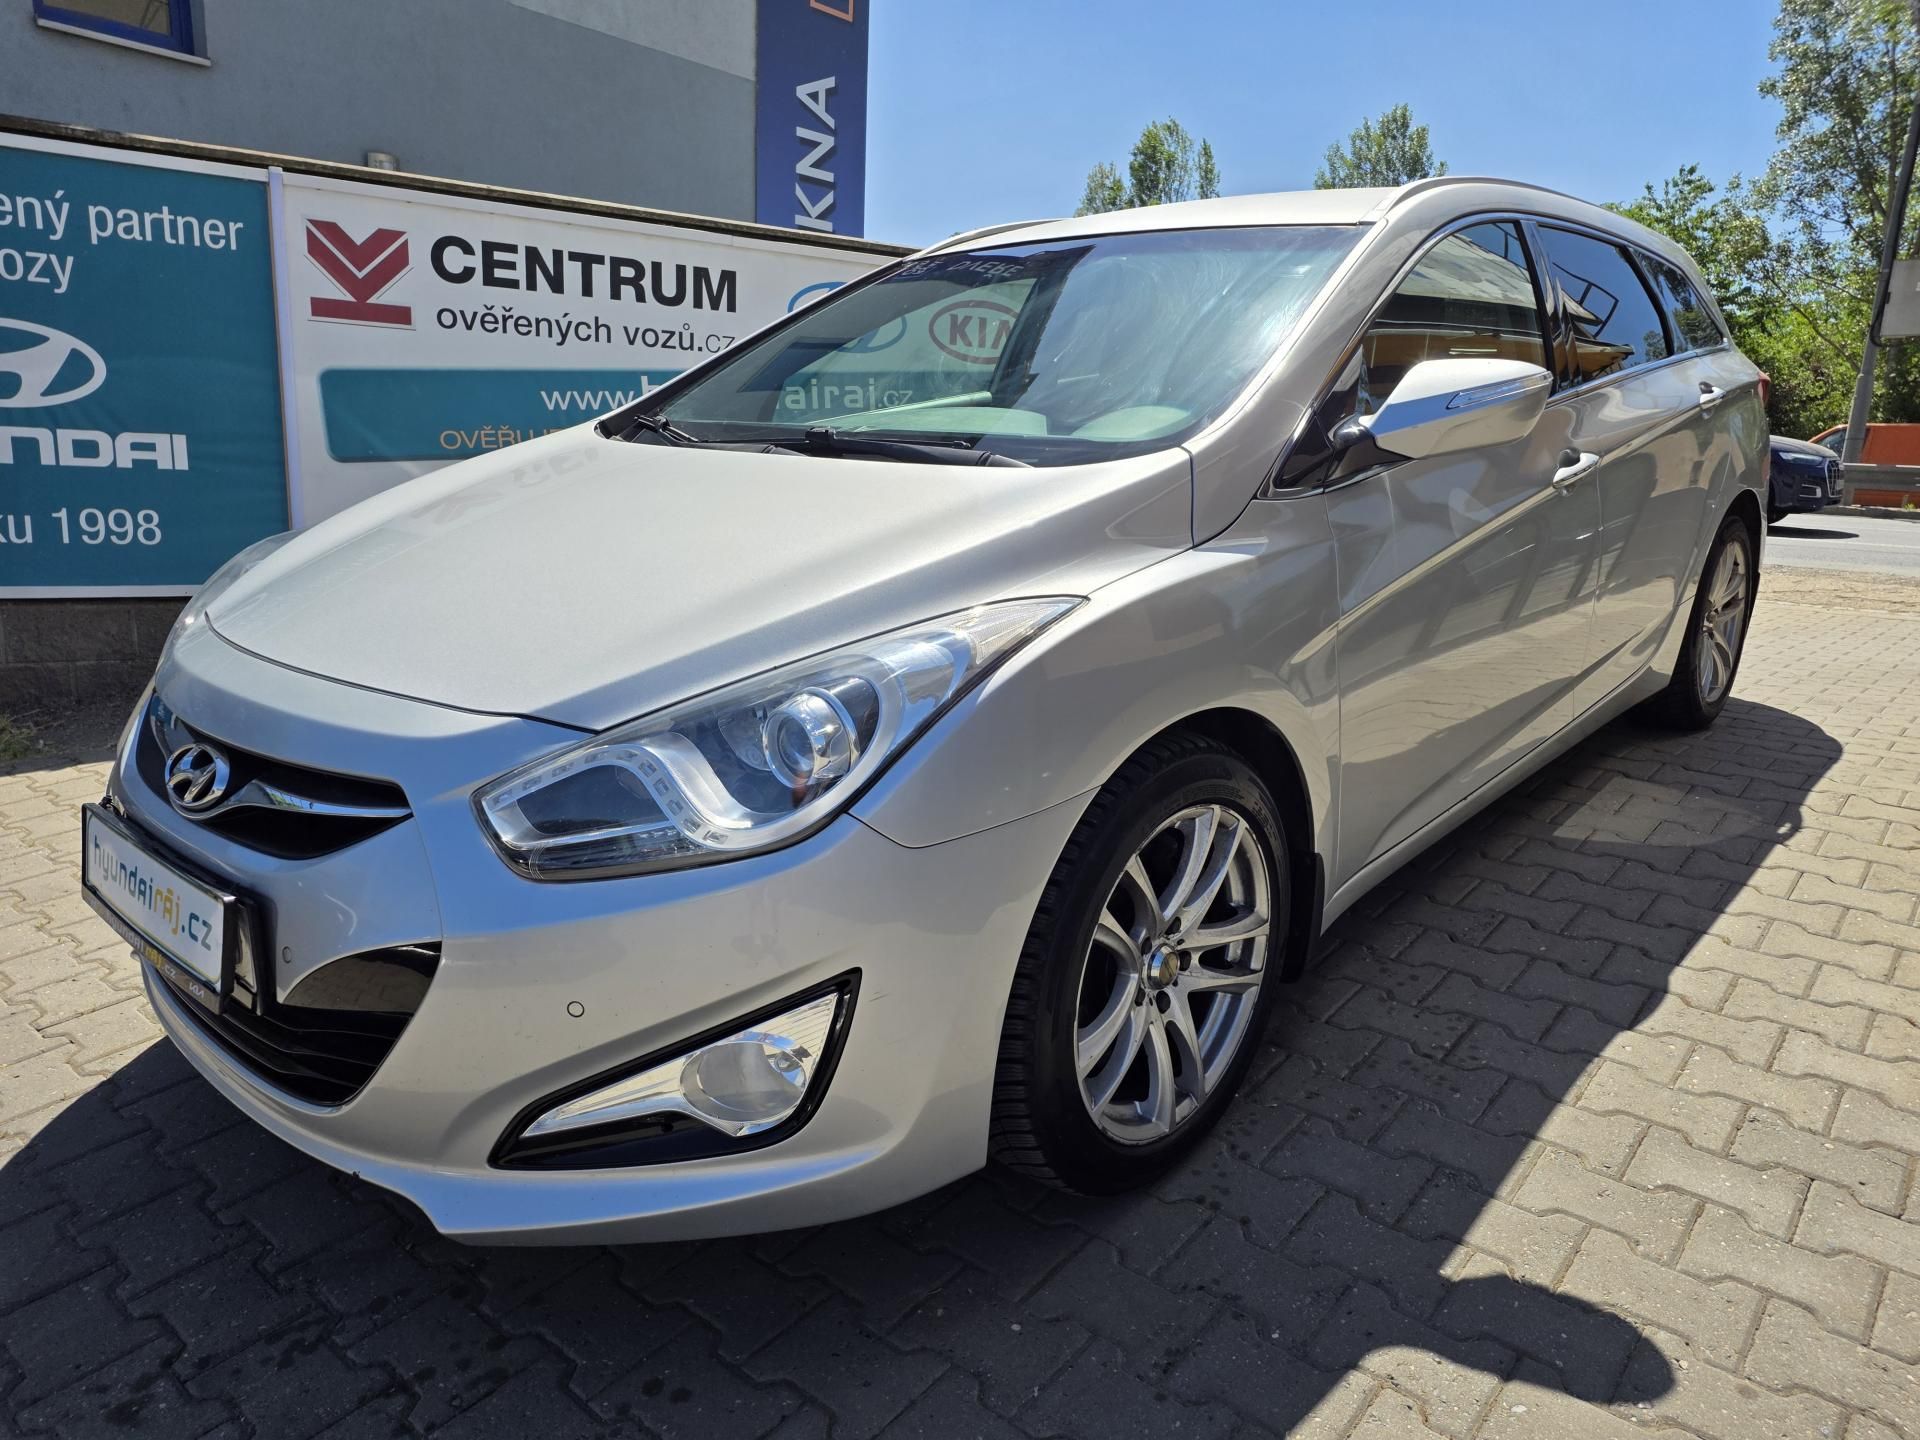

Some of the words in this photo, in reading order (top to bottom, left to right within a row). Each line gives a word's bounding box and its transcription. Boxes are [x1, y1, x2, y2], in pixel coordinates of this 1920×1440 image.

[88, 205, 243, 250] partner
[0, 248, 74, 294] ozy
[430, 235, 738, 313] CENTRUM
[436, 303, 612, 346] ověřených
[51, 507, 163, 546] 1998
